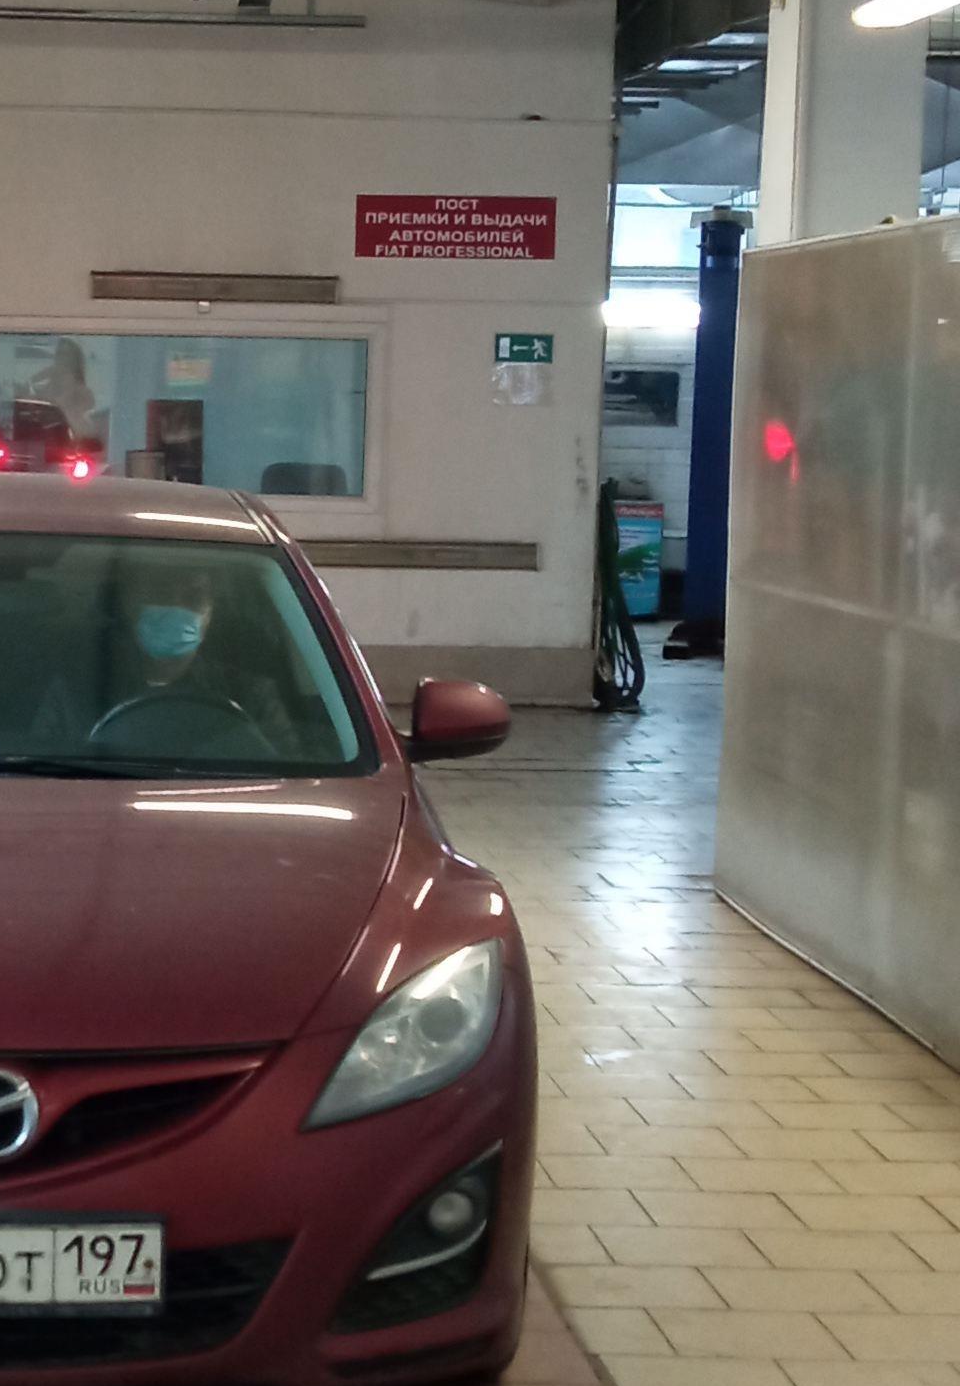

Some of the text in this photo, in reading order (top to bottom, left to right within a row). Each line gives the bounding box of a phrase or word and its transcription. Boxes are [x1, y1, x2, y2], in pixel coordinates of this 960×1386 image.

[435, 198, 479, 210] ПОСТ
[365, 212, 547, 227] ПРИЕМКИ И ВЫДАЧИ
[389, 229, 524, 243] АВТОМОБИЛЕЙ
[375, 245, 533, 258] FIAT PROFESSIONAL
[63, 1233, 145, 1277] 197
[79, 1279, 121, 1295] RUS
